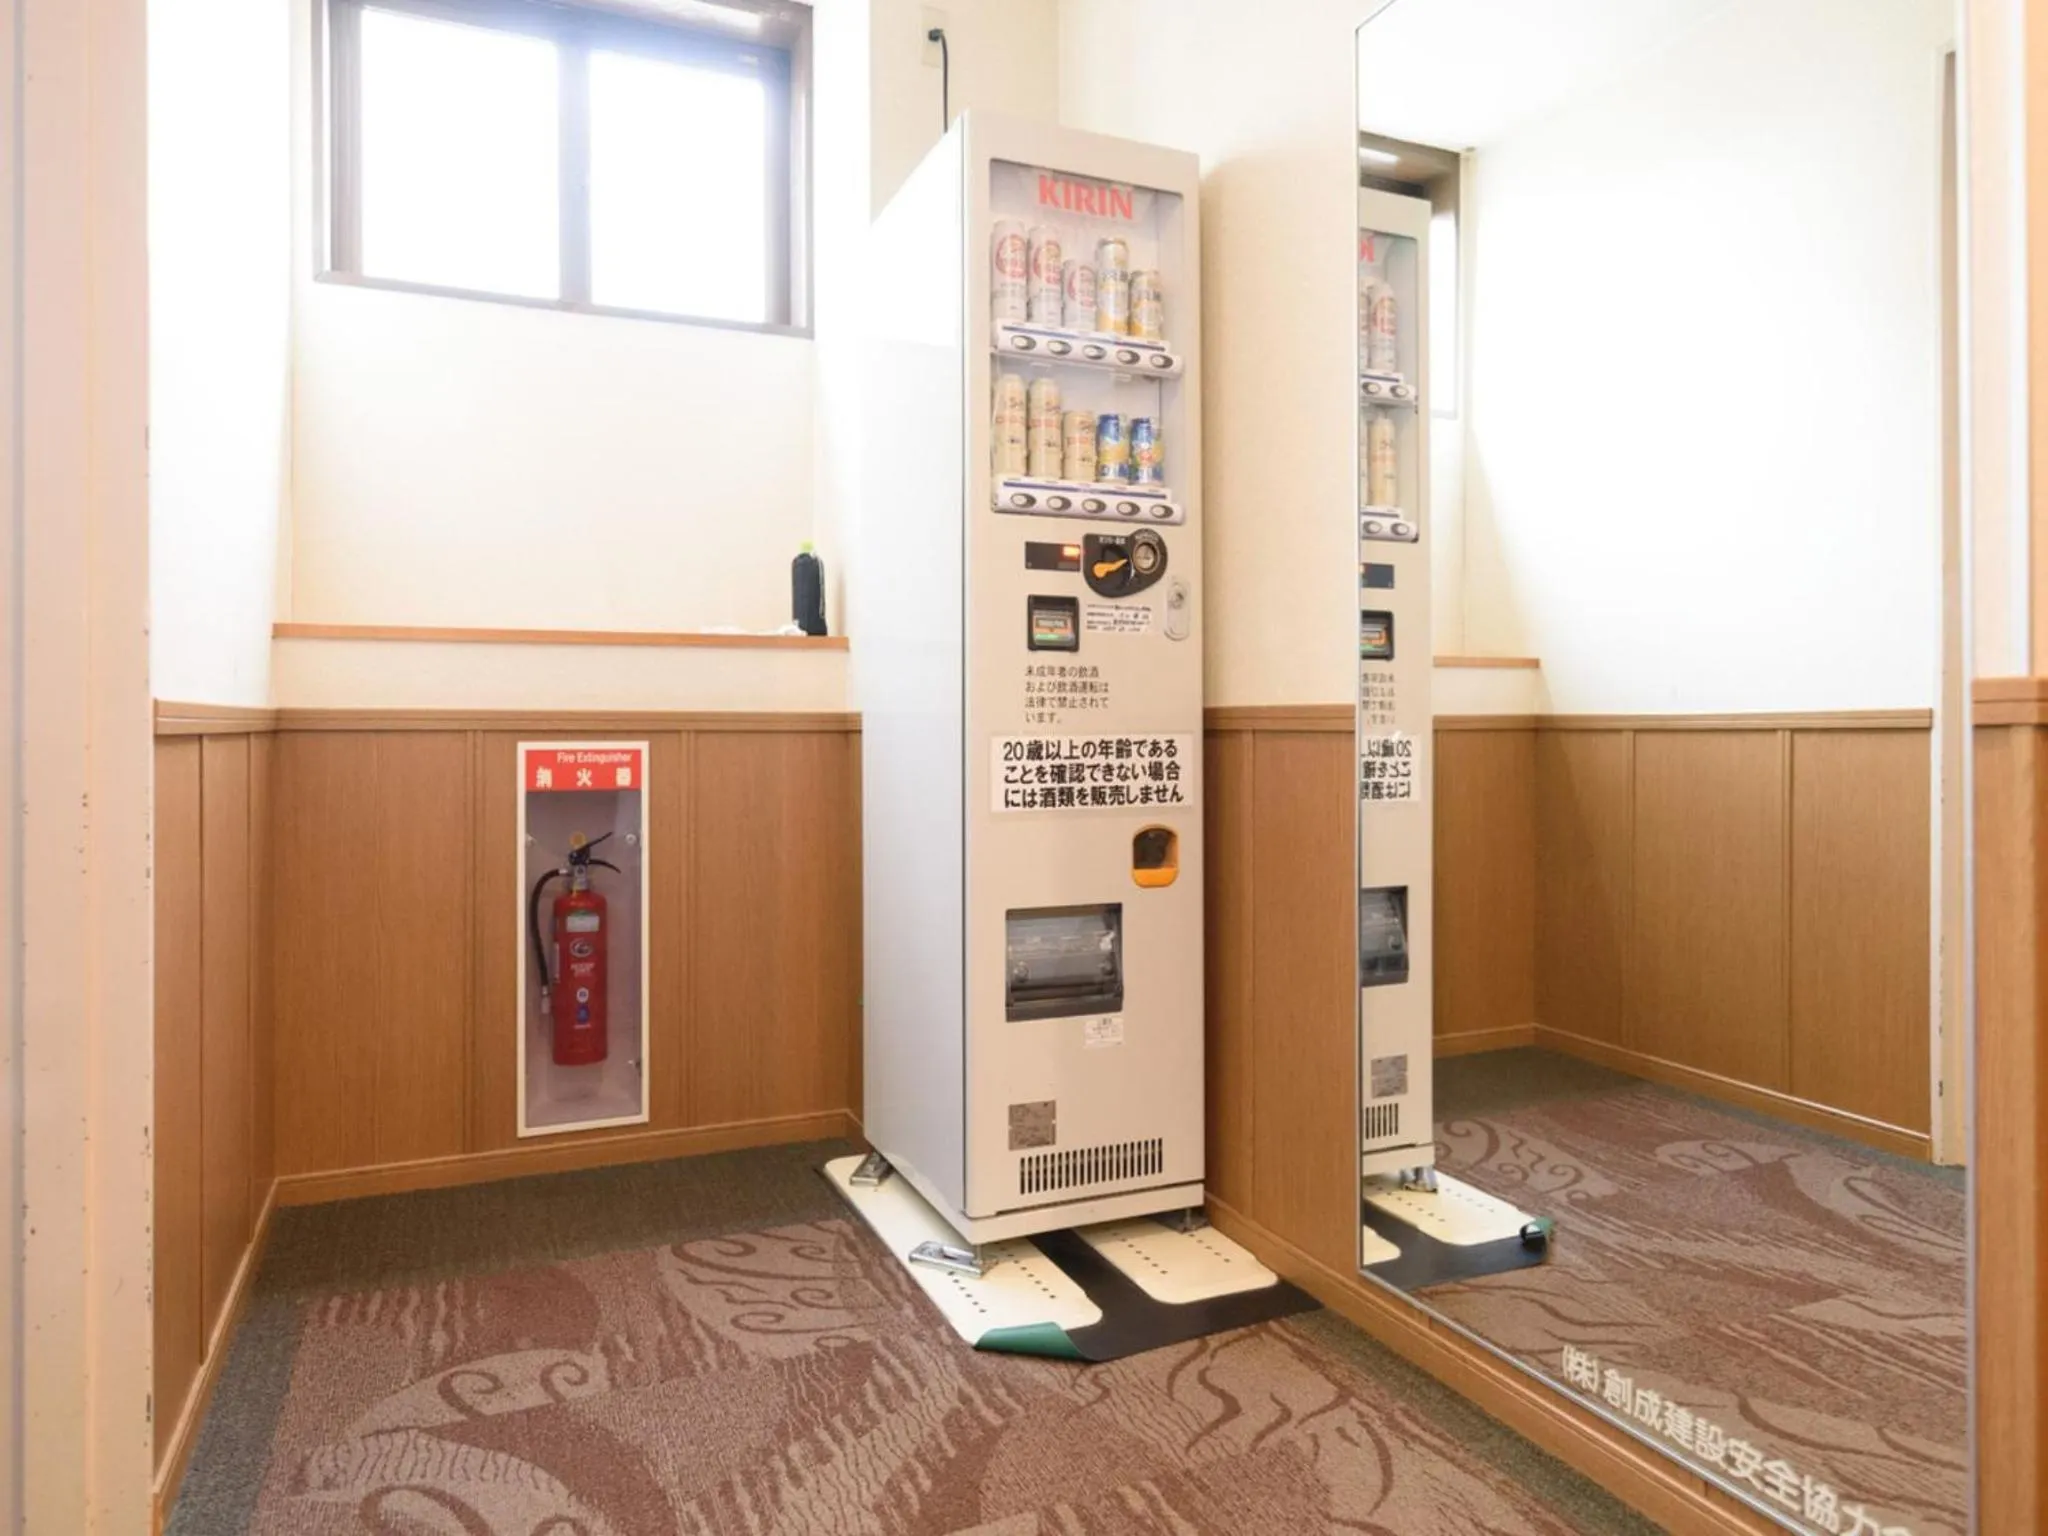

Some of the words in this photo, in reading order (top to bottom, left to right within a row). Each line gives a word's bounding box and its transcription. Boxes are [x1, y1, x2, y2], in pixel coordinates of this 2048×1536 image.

[1039, 176, 1133, 219] KIRIN
[556, 751, 576, 764] Fire
[577, 751, 633, 765] Extinguisher
[1003, 738, 1178, 761] 20歳以上の年齢である
[1004, 761, 1181, 785] ことを確認できない場合
[1004, 784, 1184, 809] には酒類を販売しません
